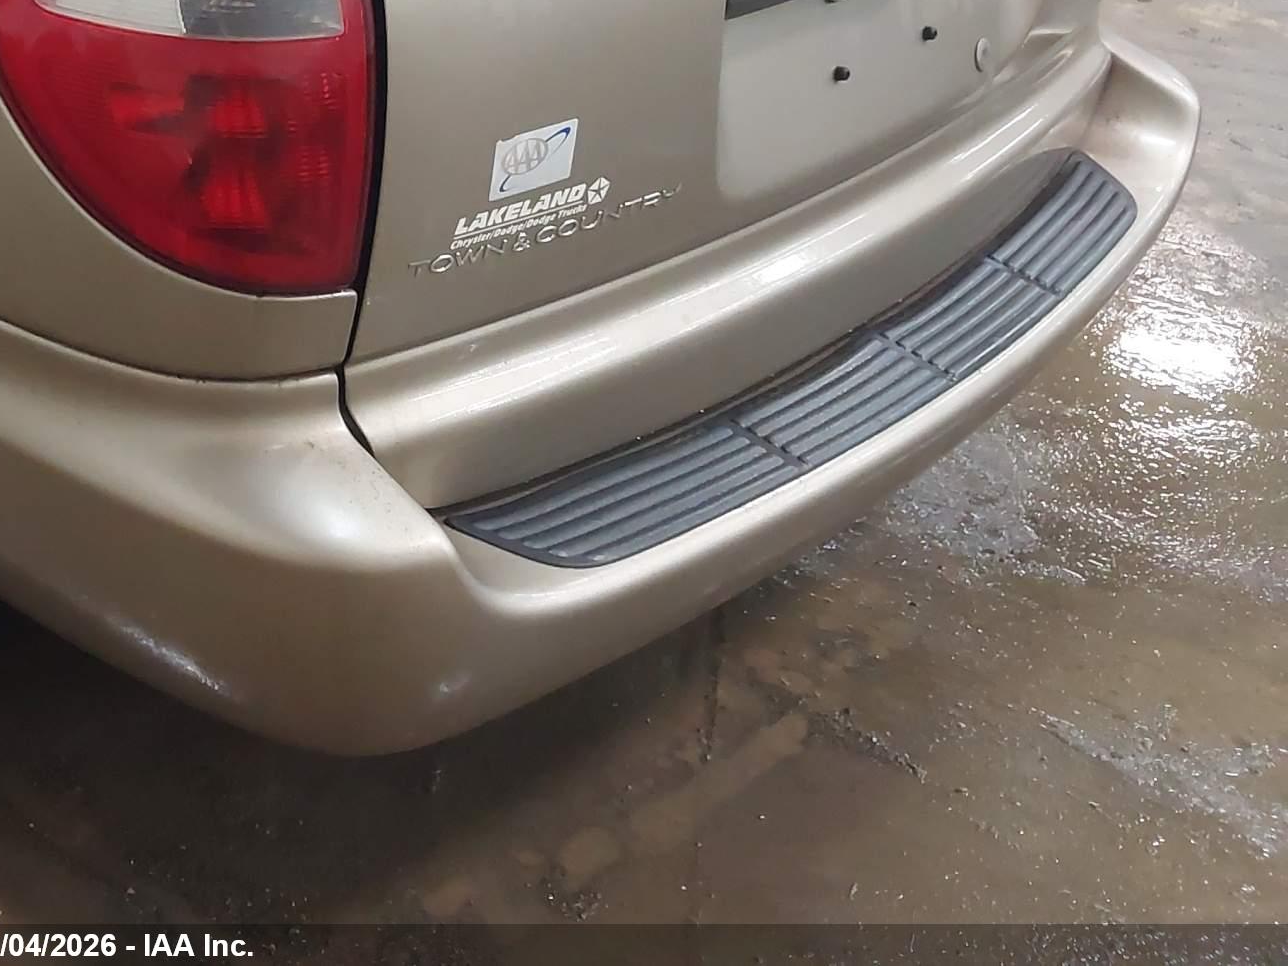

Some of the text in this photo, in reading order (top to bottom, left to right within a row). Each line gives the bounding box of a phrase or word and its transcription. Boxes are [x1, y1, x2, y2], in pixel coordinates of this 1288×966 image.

[503, 139, 545, 173] AAA
[454, 183, 587, 236] LAKELAND
[408, 239, 508, 278] TOWN
[512, 232, 531, 252] &
